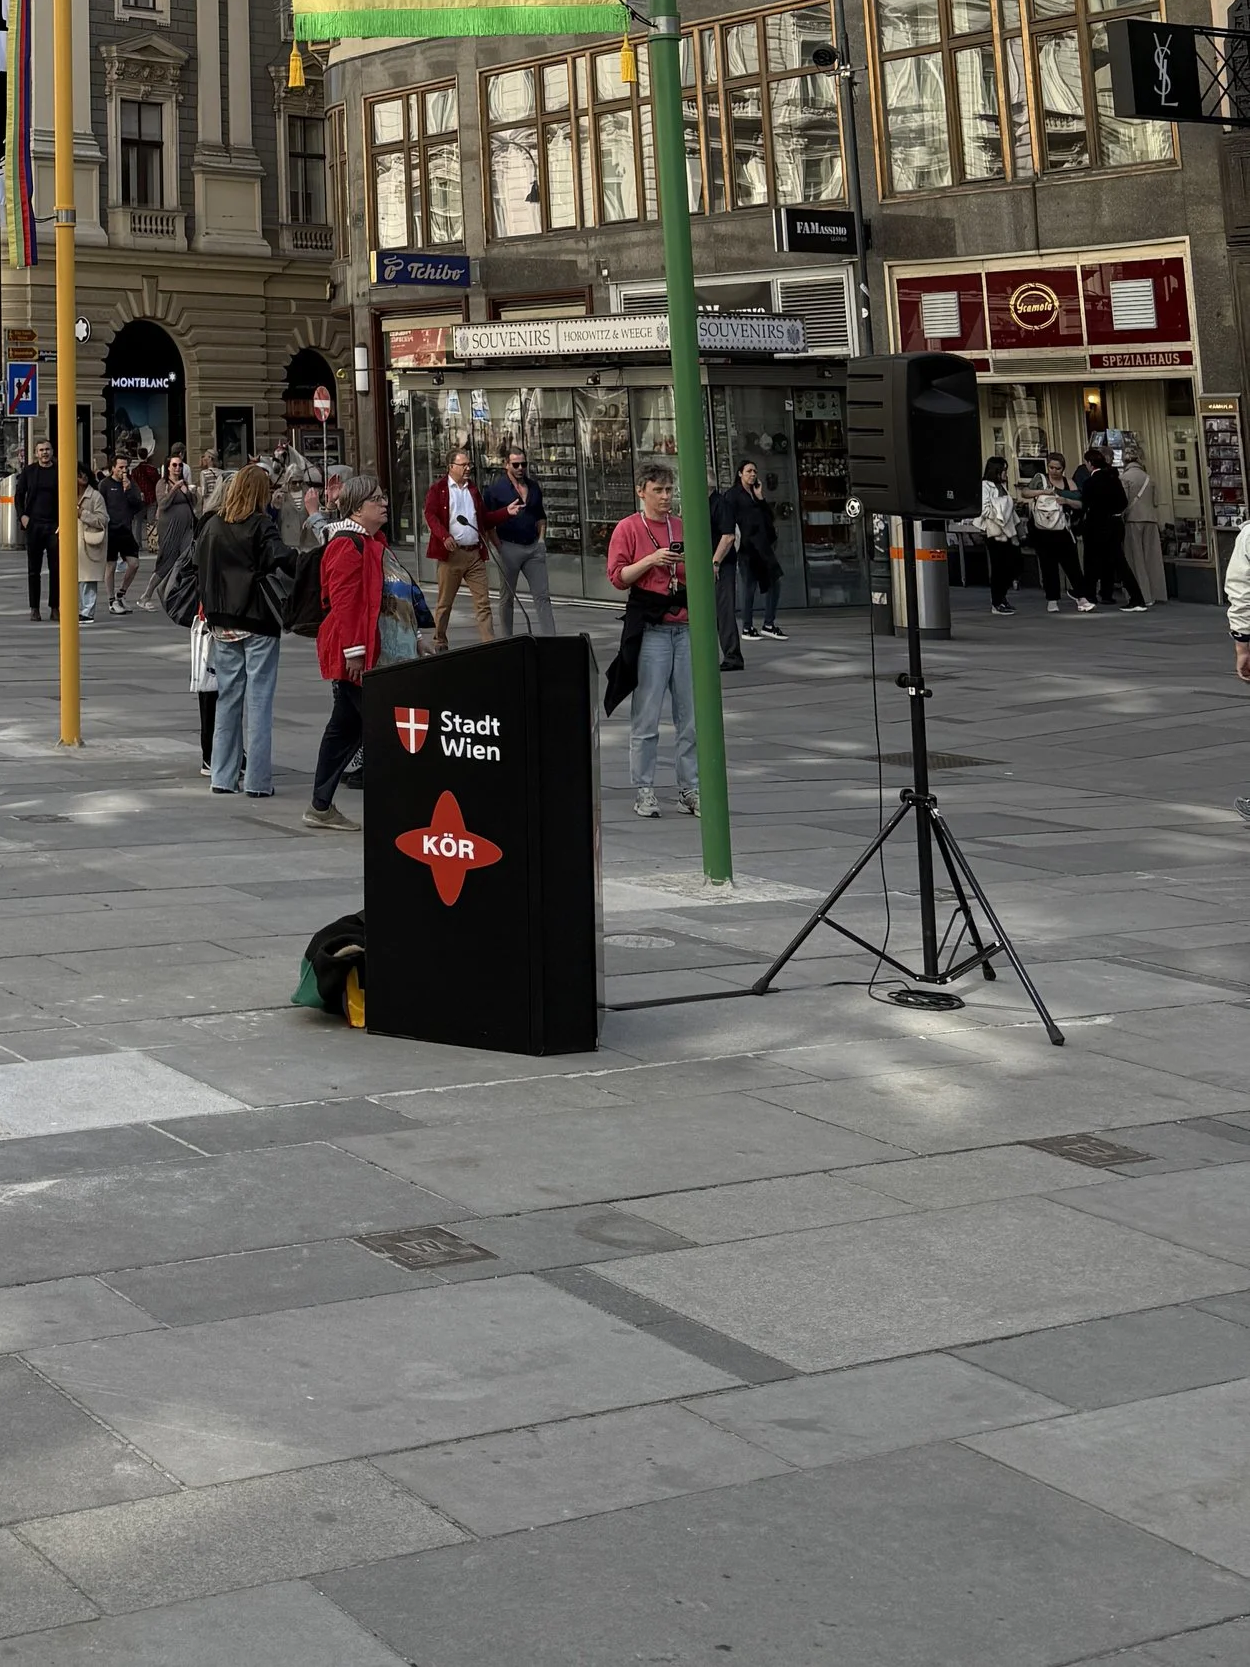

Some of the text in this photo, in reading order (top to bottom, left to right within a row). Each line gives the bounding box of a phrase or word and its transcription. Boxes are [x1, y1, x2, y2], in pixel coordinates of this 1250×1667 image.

[407, 262, 466, 281] Tchibo
[472, 324, 551, 350] SOUVENIRS
[563, 325, 653, 343] HOROWITZ & WEEGE
[699, 321, 785, 339] SOUVENIRS
[1102, 353, 1181, 367] SPEZIALHAUS
[111, 377, 169, 389] MONTBLANC
[440, 710, 501, 737] Stadt
[440, 735, 501, 762] Wien
[422, 832, 475, 860] KÖR
